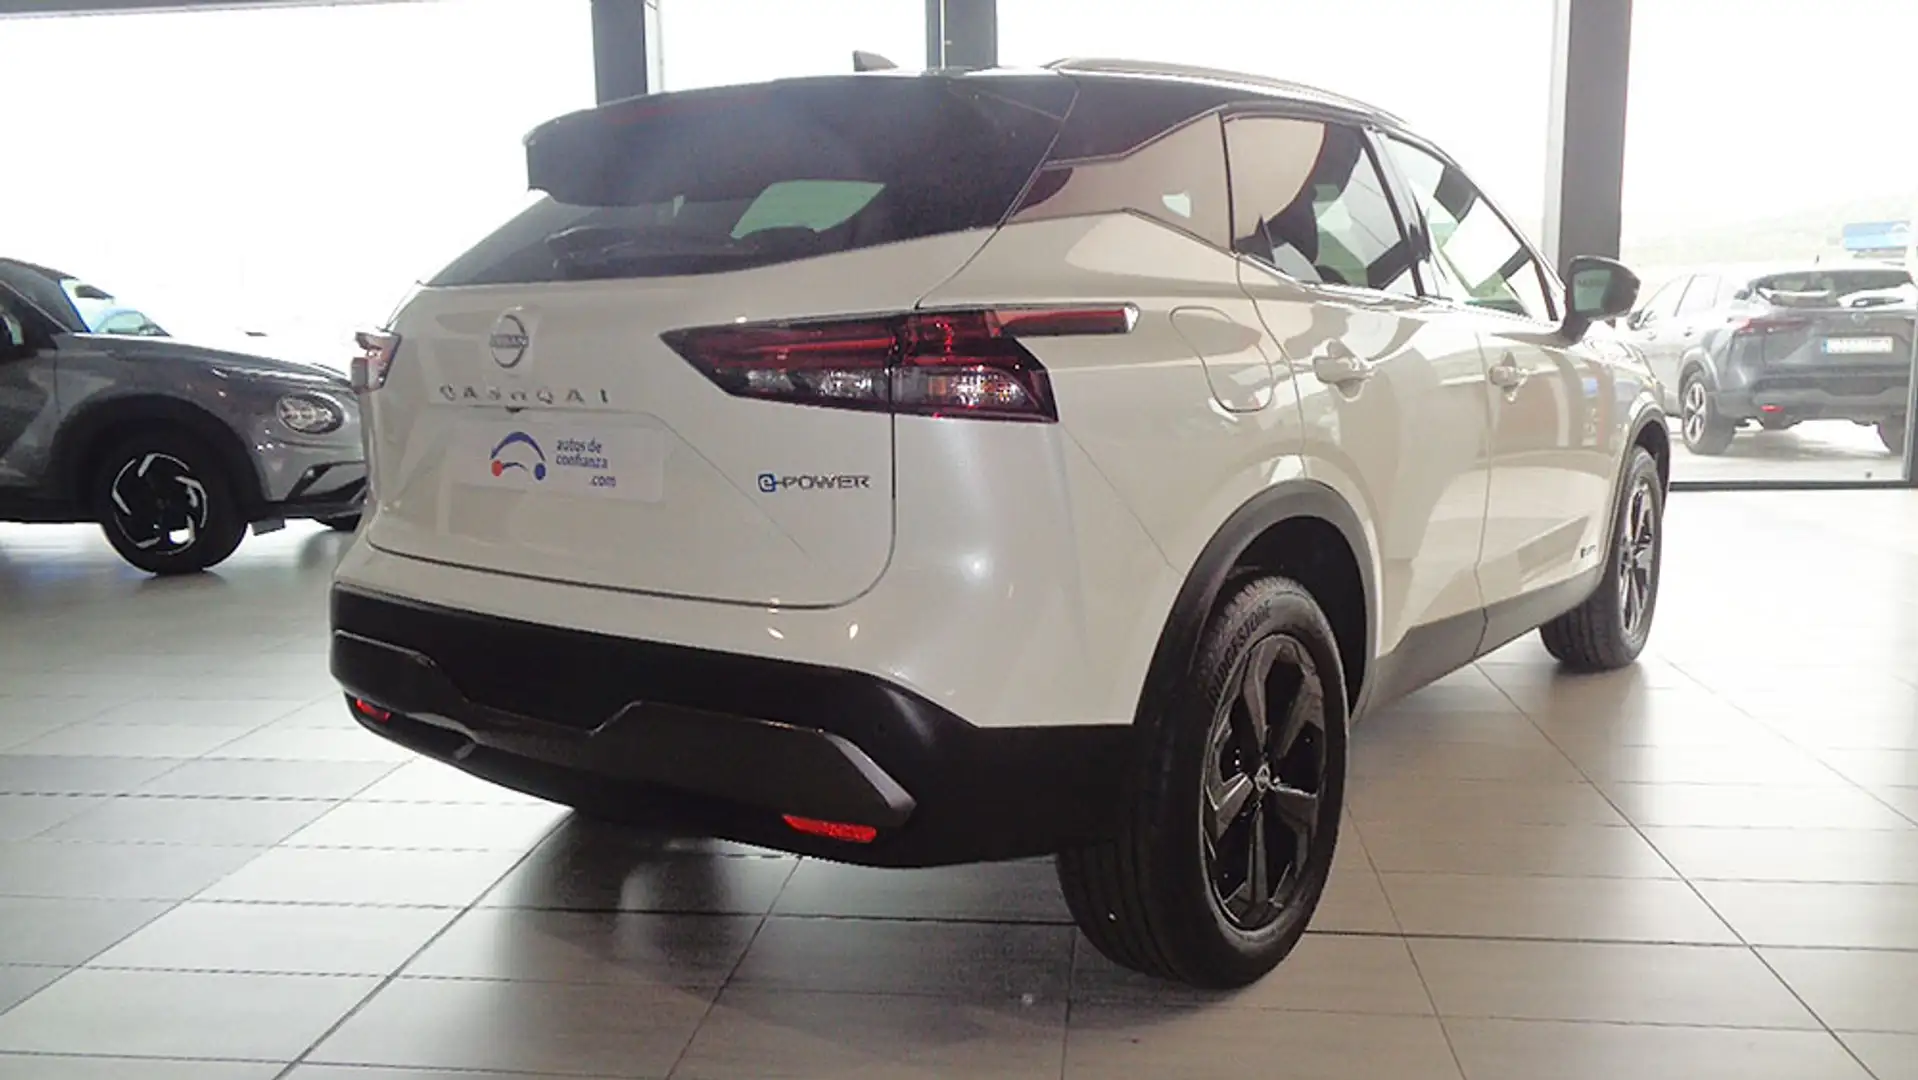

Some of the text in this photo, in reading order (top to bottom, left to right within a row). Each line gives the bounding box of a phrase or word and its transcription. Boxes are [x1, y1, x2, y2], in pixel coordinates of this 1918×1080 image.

[556, 436, 602, 454] autos de
[556, 454, 608, 469] confianza
[589, 475, 616, 489] .com
[757, 472, 872, 494] e-POWER
